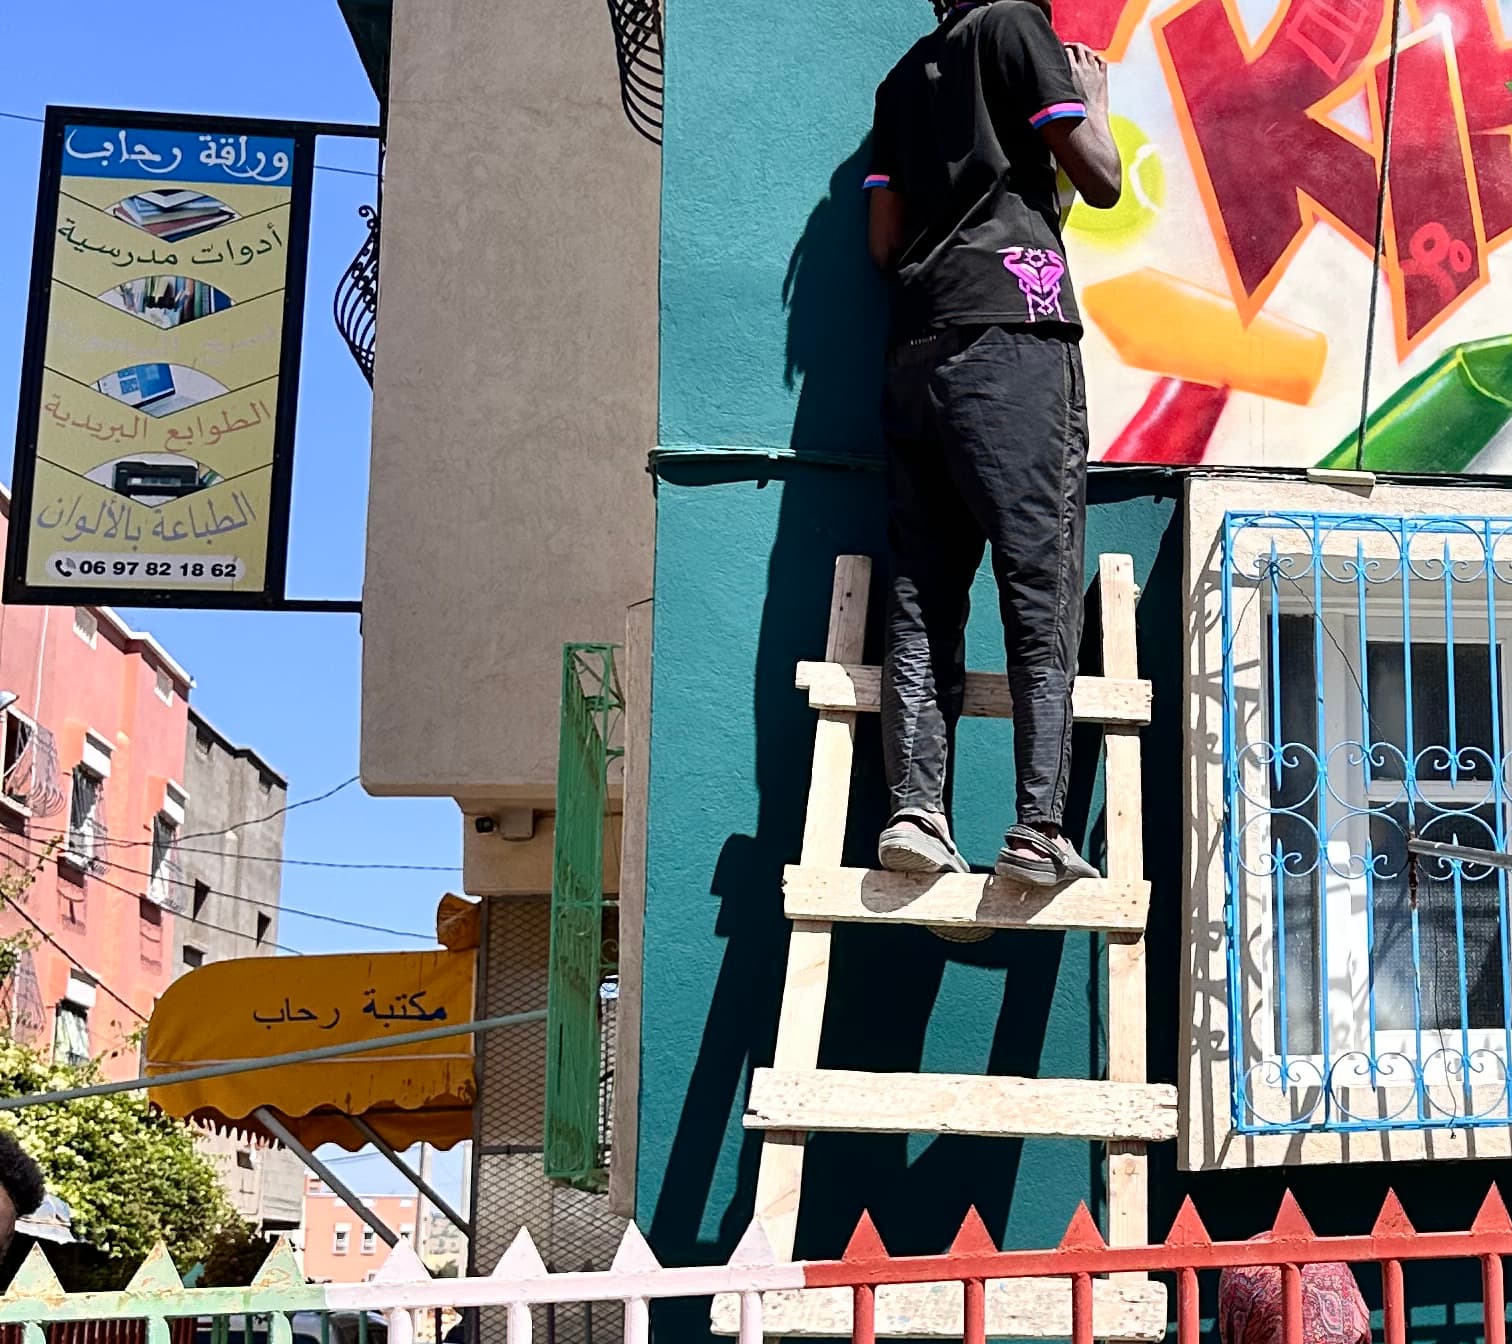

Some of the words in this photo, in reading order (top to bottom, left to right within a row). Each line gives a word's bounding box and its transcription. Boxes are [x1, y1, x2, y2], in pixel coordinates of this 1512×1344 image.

[65, 129, 183, 174] رحاب
[198, 134, 290, 182] وراقة
[57, 217, 180, 268] مدرسية
[191, 222, 284, 266] أدوات
[44, 393, 149, 443] البريدية
[163, 400, 272, 452] الطوابع
[36, 495, 142, 552] بالألوان
[152, 490, 257, 545] الطباعة
[79, 560, 106, 576] 06
[112, 561, 139, 576] 97
[145, 562, 172, 576] 82
[180, 562, 204, 577] 18
[211, 563, 237, 578] 62
[253, 997, 341, 1030] رحاب
[362, 988, 448, 1029] مكتبة
